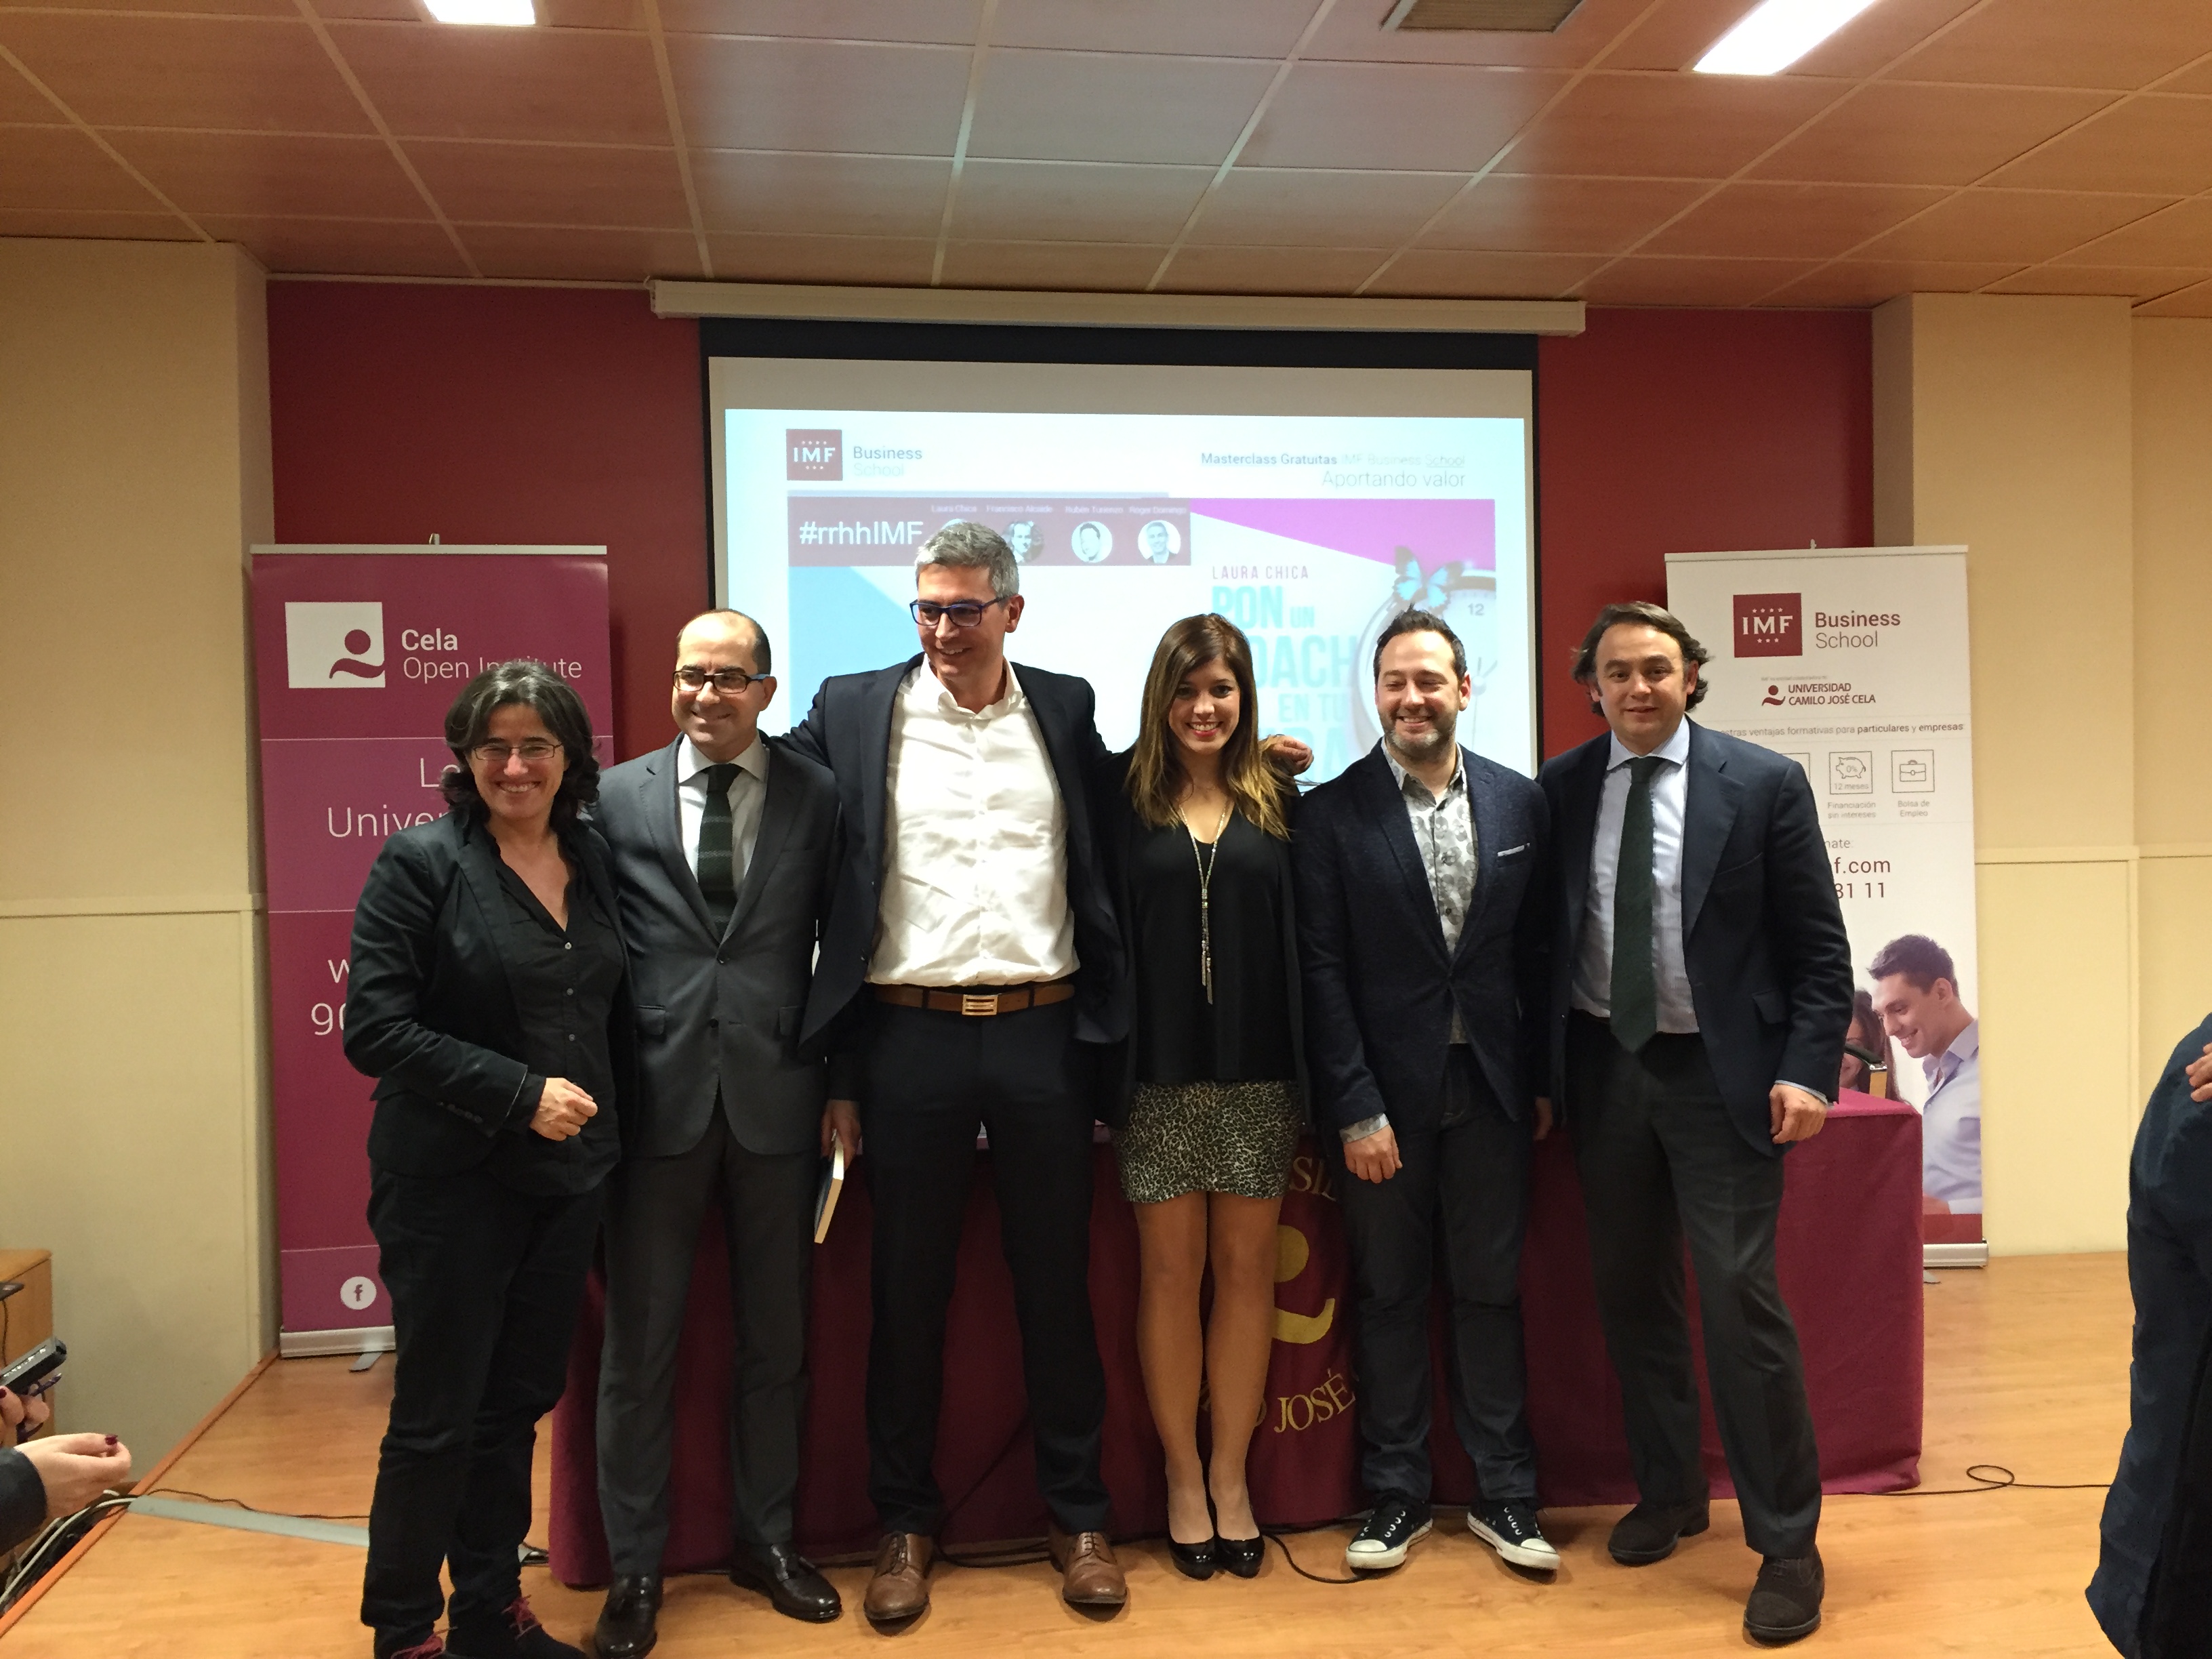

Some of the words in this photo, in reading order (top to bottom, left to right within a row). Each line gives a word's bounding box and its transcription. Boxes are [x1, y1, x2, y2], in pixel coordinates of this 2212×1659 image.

[793, 447, 836, 463] IMF
[853, 445, 923, 460] Business
[1201, 453, 1277, 464] Masterclass
[1281, 453, 1338, 465] Gratuitas
[1368, 453, 1421, 466] Business
[1425, 454, 1465, 466] School
[854, 462, 905, 477] School
[1322, 470, 1417, 489] Aportando
[1423, 470, 1466, 487] valor
[799, 520, 924, 545] #rrhhIMF
[1212, 565, 1258, 579] LAURA
[1265, 565, 1309, 579] CHICA
[1211, 586, 1284, 630] PON
[1289, 606, 1315, 629] UN
[1468, 602, 1485, 616] 12
[1742, 615, 1794, 635] IMF
[1814, 610, 1901, 628] Business
[401, 628, 459, 651] Cela
[1816, 630, 1879, 649] School
[1248, 634, 1357, 689] OACH
[403, 656, 470, 684] Open
[1788, 682, 1852, 694] UNIVERSIDAD
[1788, 695, 1826, 706] CAMILO
[1827, 693, 1850, 705] JOSÉ
[1851, 694, 1877, 704] CELA
[1749, 728, 1786, 737] ventajas
[1787, 726, 1834, 735] formativas
[1836, 726, 1856, 736] para
[1857, 724, 1910, 735] particulares
[1911, 724, 1917, 733] y
[1919, 722, 1964, 733] empresas
[1827, 801, 1877, 809] Financiación
[1898, 800, 1919, 808] Bolsa
[1900, 809, 1929, 819] Empleo
[1834, 856, 1891, 874] f.com
[1865, 882, 1885, 899] 11
[1273, 1367, 1357, 1434] JOSÉ
